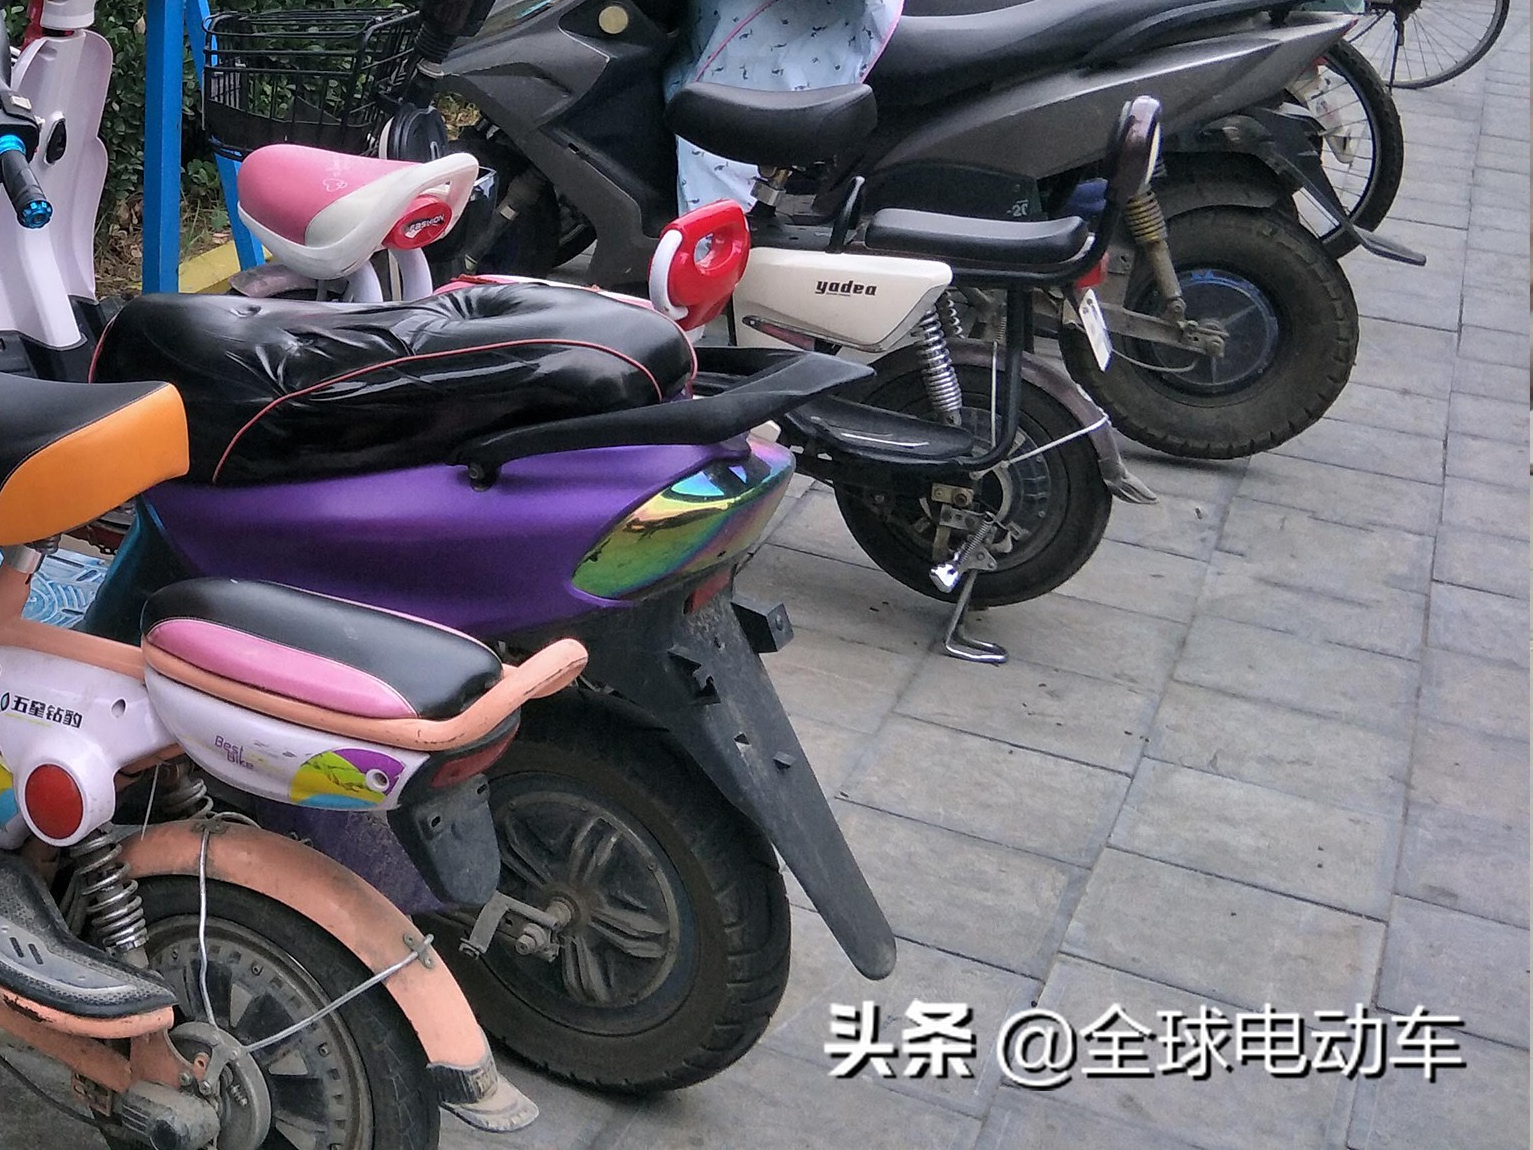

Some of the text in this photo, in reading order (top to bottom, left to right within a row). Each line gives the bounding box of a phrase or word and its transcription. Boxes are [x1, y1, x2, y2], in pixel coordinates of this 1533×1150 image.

[814, 280, 877, 296] yadea
[11, 695, 83, 729] 五星钻豹
